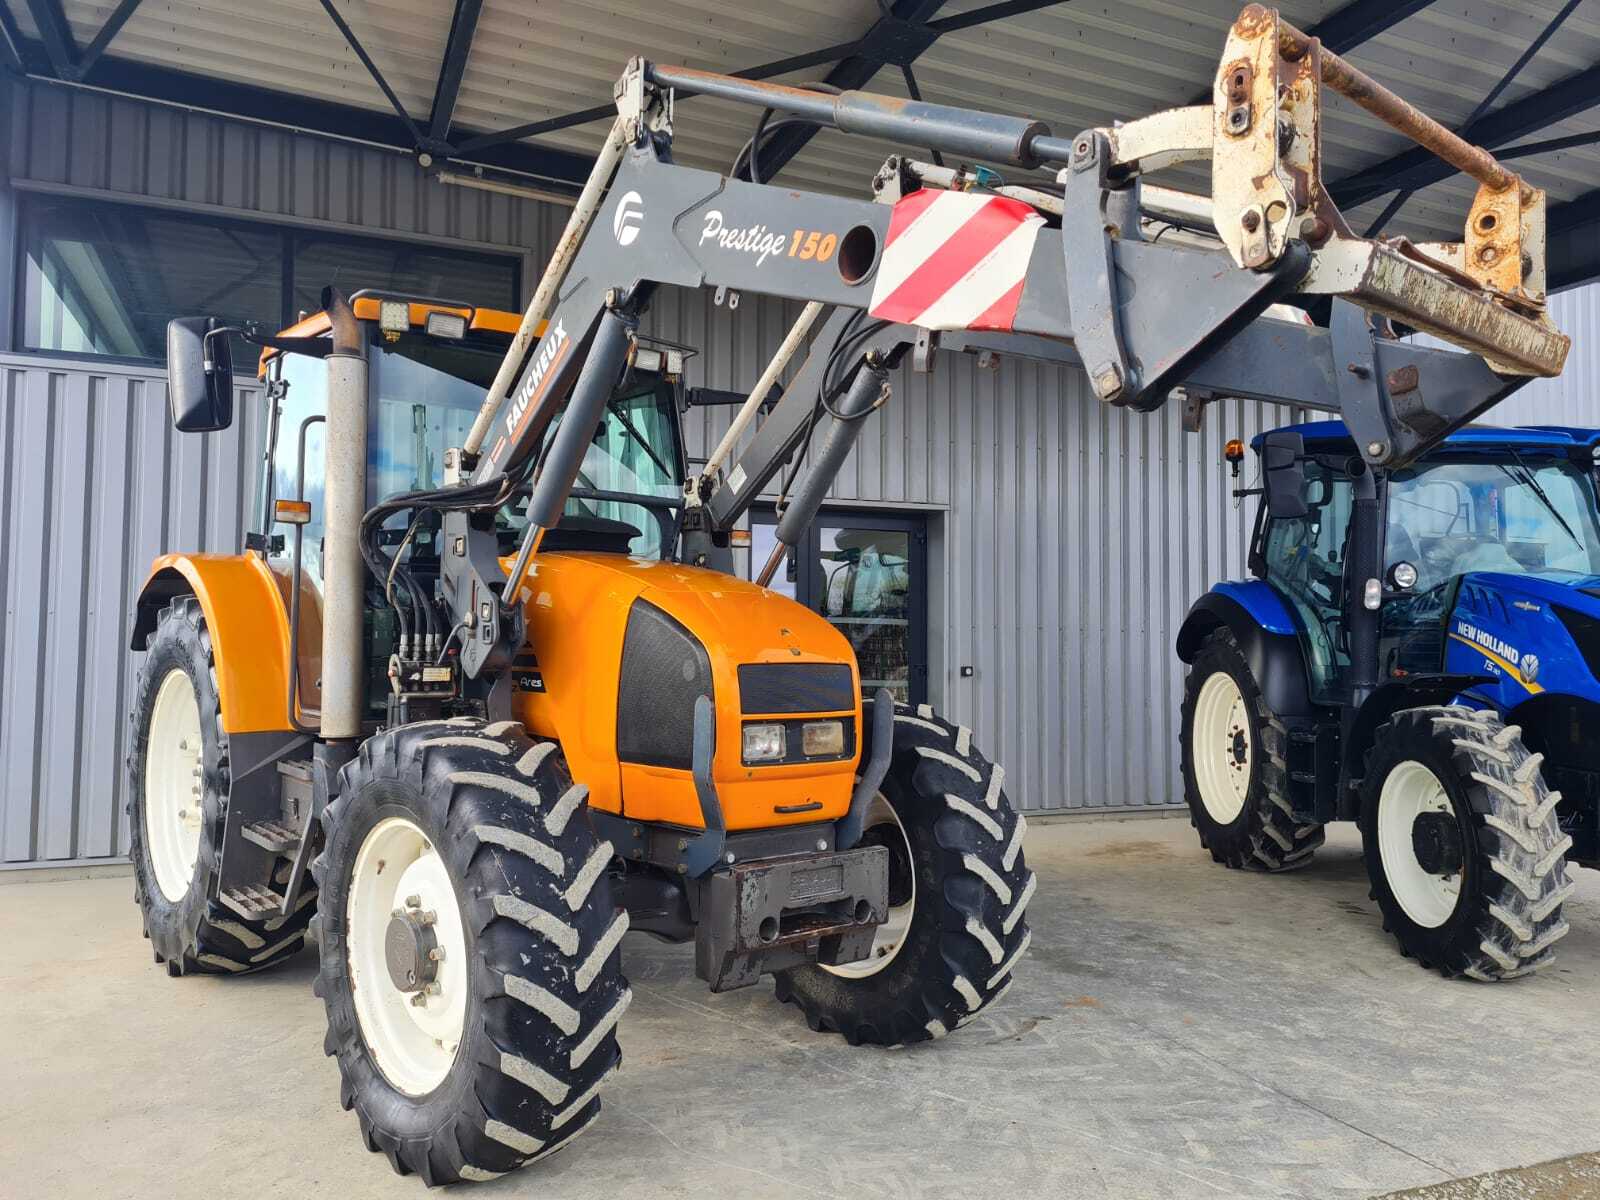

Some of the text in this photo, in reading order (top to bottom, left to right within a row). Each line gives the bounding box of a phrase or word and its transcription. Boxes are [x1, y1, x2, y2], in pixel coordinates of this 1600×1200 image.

[698, 209, 839, 267] Prestige 150
[505, 317, 567, 435] FAUCHEUX
[1457, 621, 1519, 664] NEW HOLLAND
[520, 676, 542, 688] Ares
